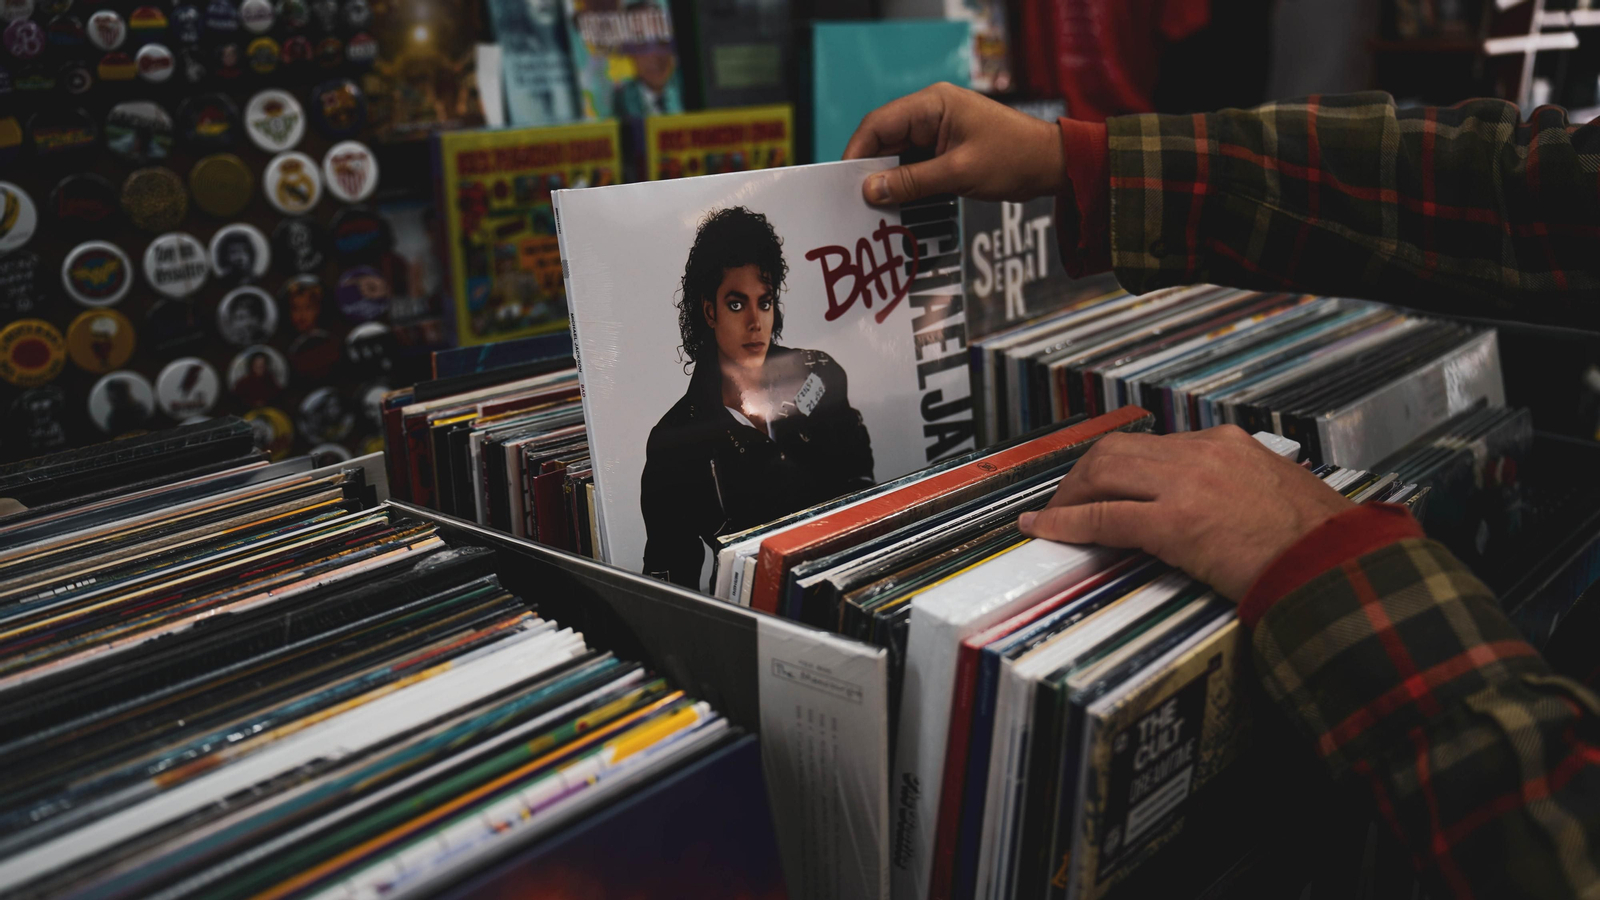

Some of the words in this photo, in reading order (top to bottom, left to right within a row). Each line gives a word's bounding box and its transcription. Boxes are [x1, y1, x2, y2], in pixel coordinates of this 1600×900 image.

[805, 219, 919, 324] BAD
[570, 313, 578, 341] MICHAEL
[574, 342, 583, 373] JACKSON
[1133, 717, 1186, 772] CULT
[1136, 697, 1179, 743] THE
